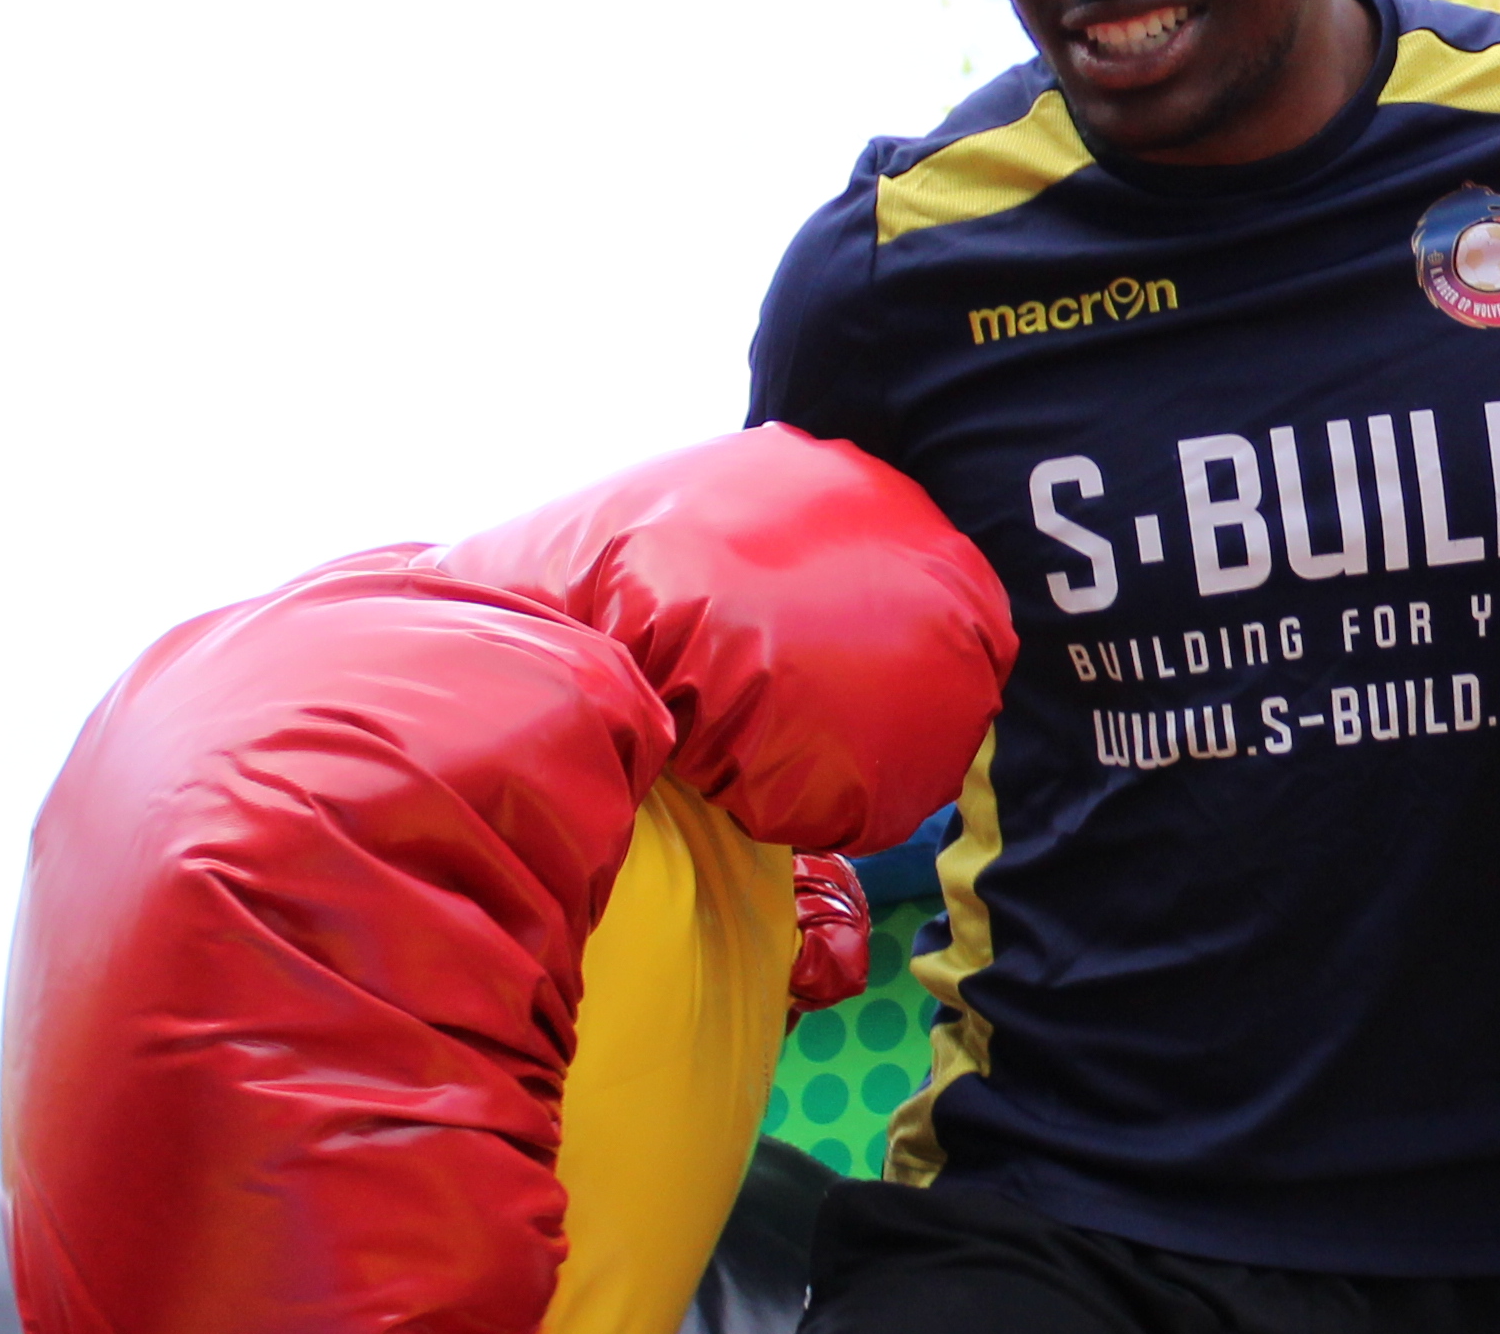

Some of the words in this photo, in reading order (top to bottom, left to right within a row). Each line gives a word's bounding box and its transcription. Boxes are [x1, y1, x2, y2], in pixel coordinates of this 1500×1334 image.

[968, 276, 1179, 345] macron
[1457, 296, 1472, 313] OP
[1067, 616, 1304, 682] BUILDING
[1342, 601, 1433, 653] FOR
